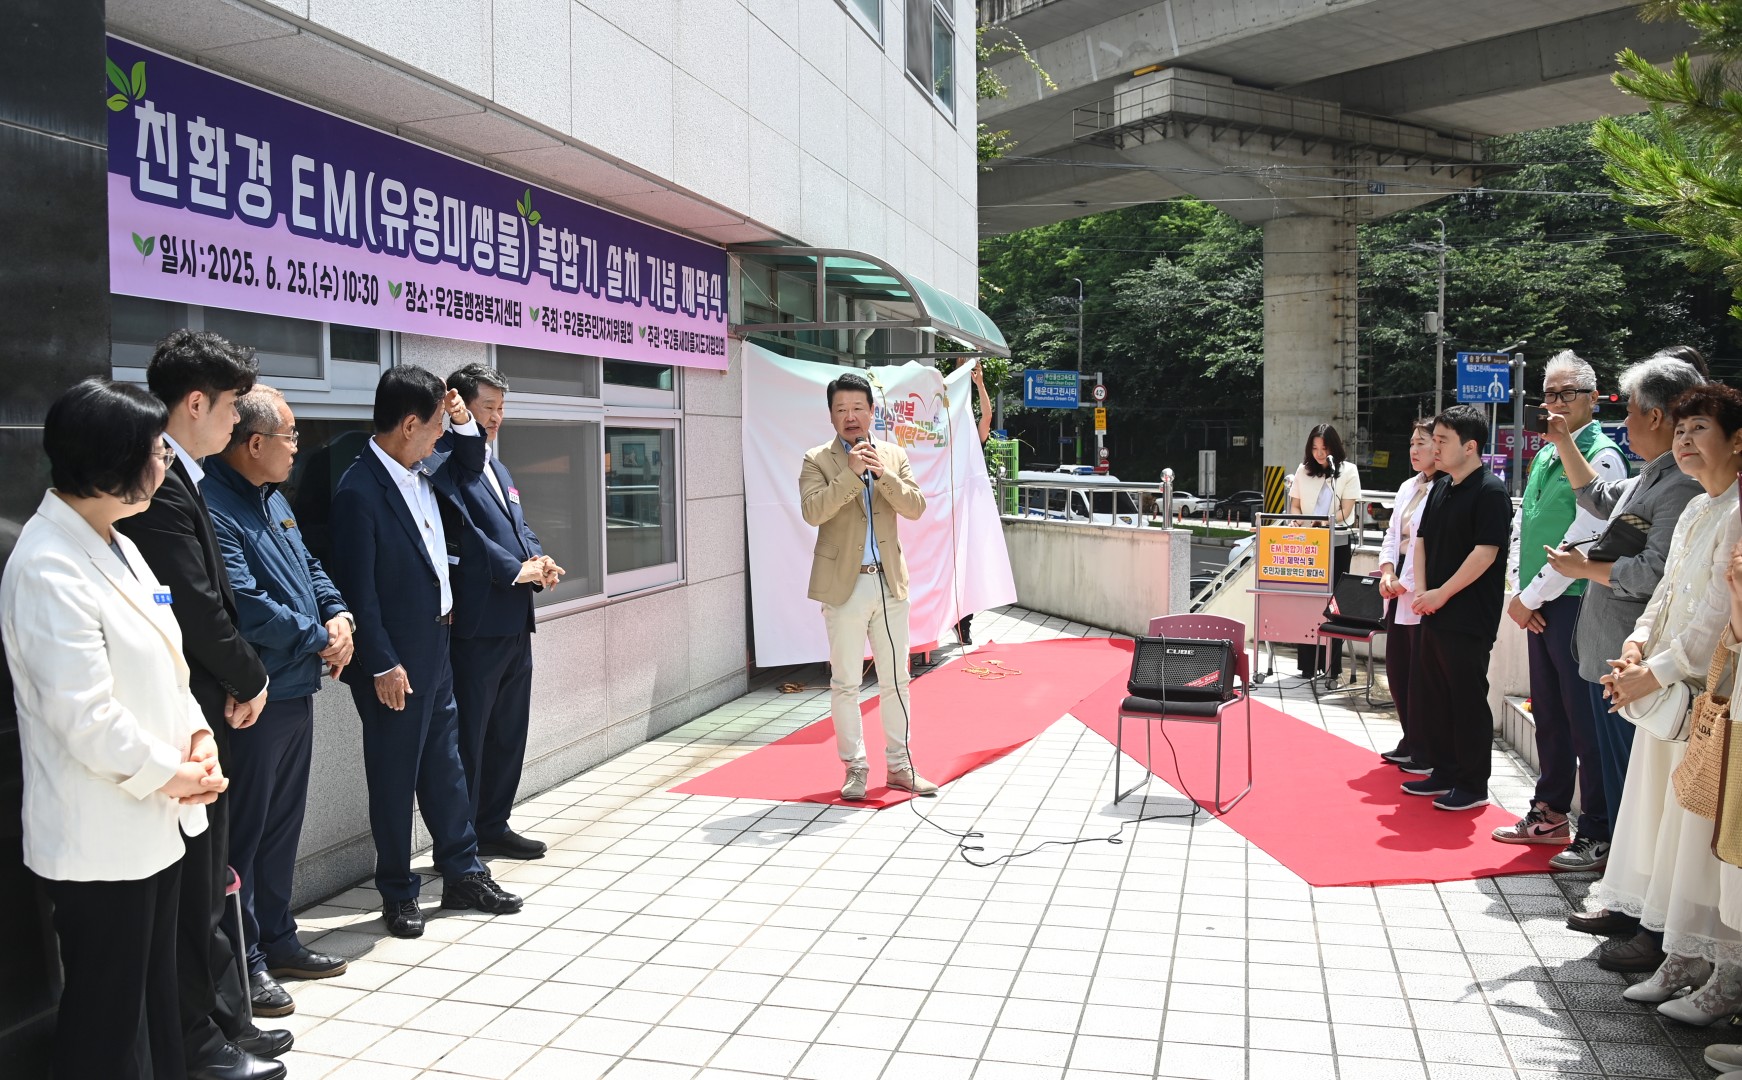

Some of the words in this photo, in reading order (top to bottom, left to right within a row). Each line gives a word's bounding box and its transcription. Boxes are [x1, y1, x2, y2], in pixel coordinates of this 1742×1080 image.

[134, 99, 272, 220] 친환경
[537, 222, 599, 293] 복합기
[606, 245, 640, 302] 설치
[646, 255, 676, 309] 기념
[681, 265, 722, 318] 제막식
[266, 255, 281, 291] 6.
[1034, 386, 1077, 397] 해운대그린시티
[1270, 544, 1282, 553] EM
[1284, 545, 1303, 554] 복합기
[1304, 546, 1317, 555] 설치
[1272, 555, 1285, 565] 기념
[1287, 556, 1306, 566] 제막식
[1307, 557, 1315, 566] 및
[1166, 648, 1195, 656] CUBE
